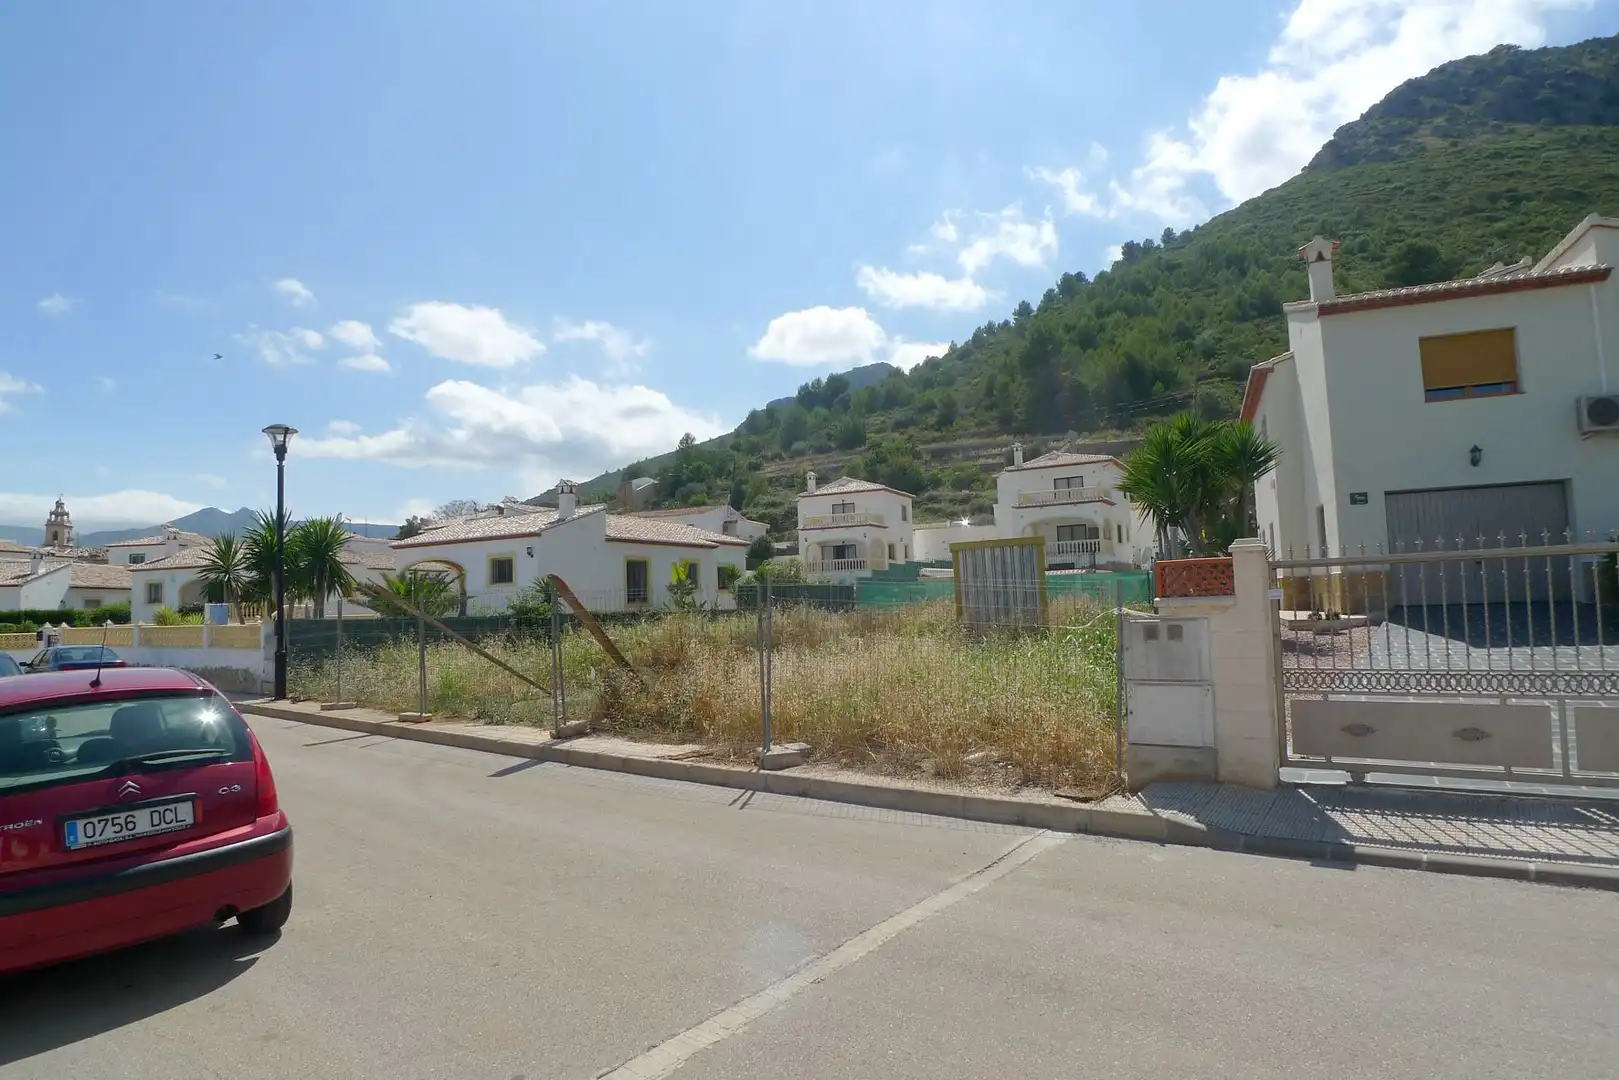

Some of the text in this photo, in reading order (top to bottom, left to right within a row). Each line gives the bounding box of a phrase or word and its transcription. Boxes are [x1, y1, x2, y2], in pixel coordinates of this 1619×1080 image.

[218, 784, 241, 795] C3
[83, 814, 137, 839] 0756
[150, 806, 187, 828] DCL
